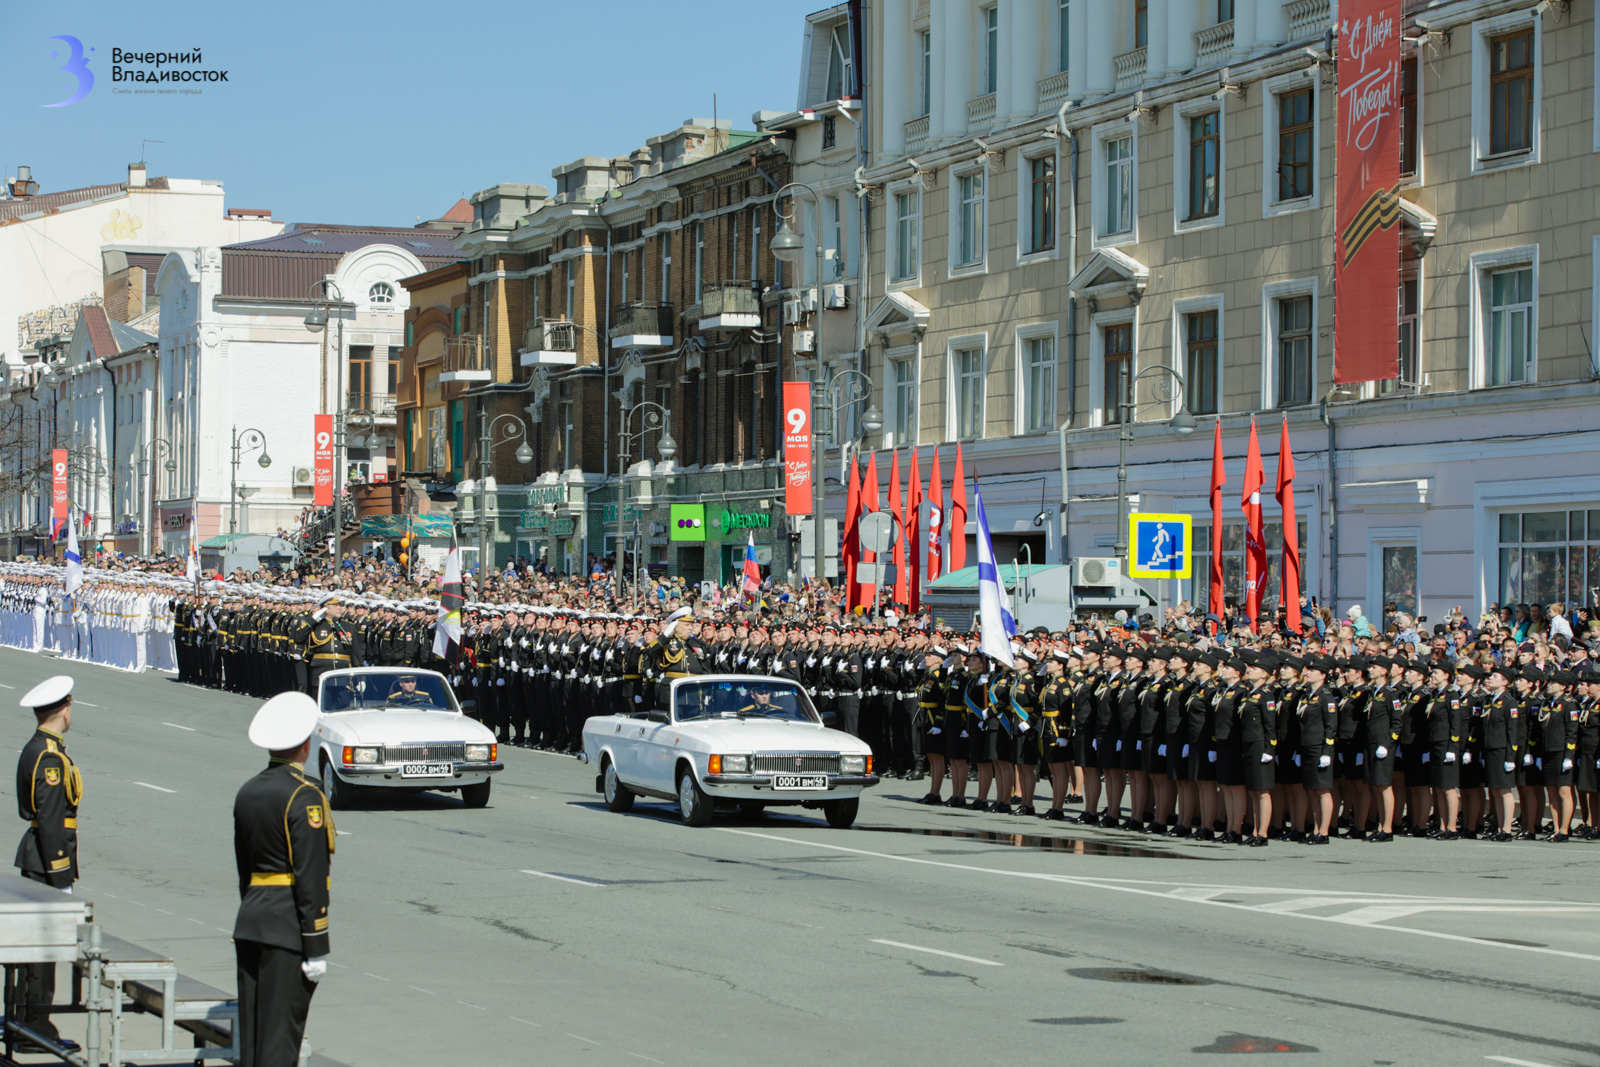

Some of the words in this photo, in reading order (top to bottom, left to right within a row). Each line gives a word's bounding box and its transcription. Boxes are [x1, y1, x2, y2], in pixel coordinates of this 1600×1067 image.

[1349, 18, 1363, 60] С
[1360, 10, 1392, 73] Днём
[1340, 60, 1398, 150] Победы!
[787, 408, 806, 434] 9
[316, 431, 330, 449] 9
[55, 462, 66, 476] 9
[730, 512, 770, 529] МЕГАФОН
[406, 765, 428, 774] 0002
[778, 777, 801, 786] 0001
